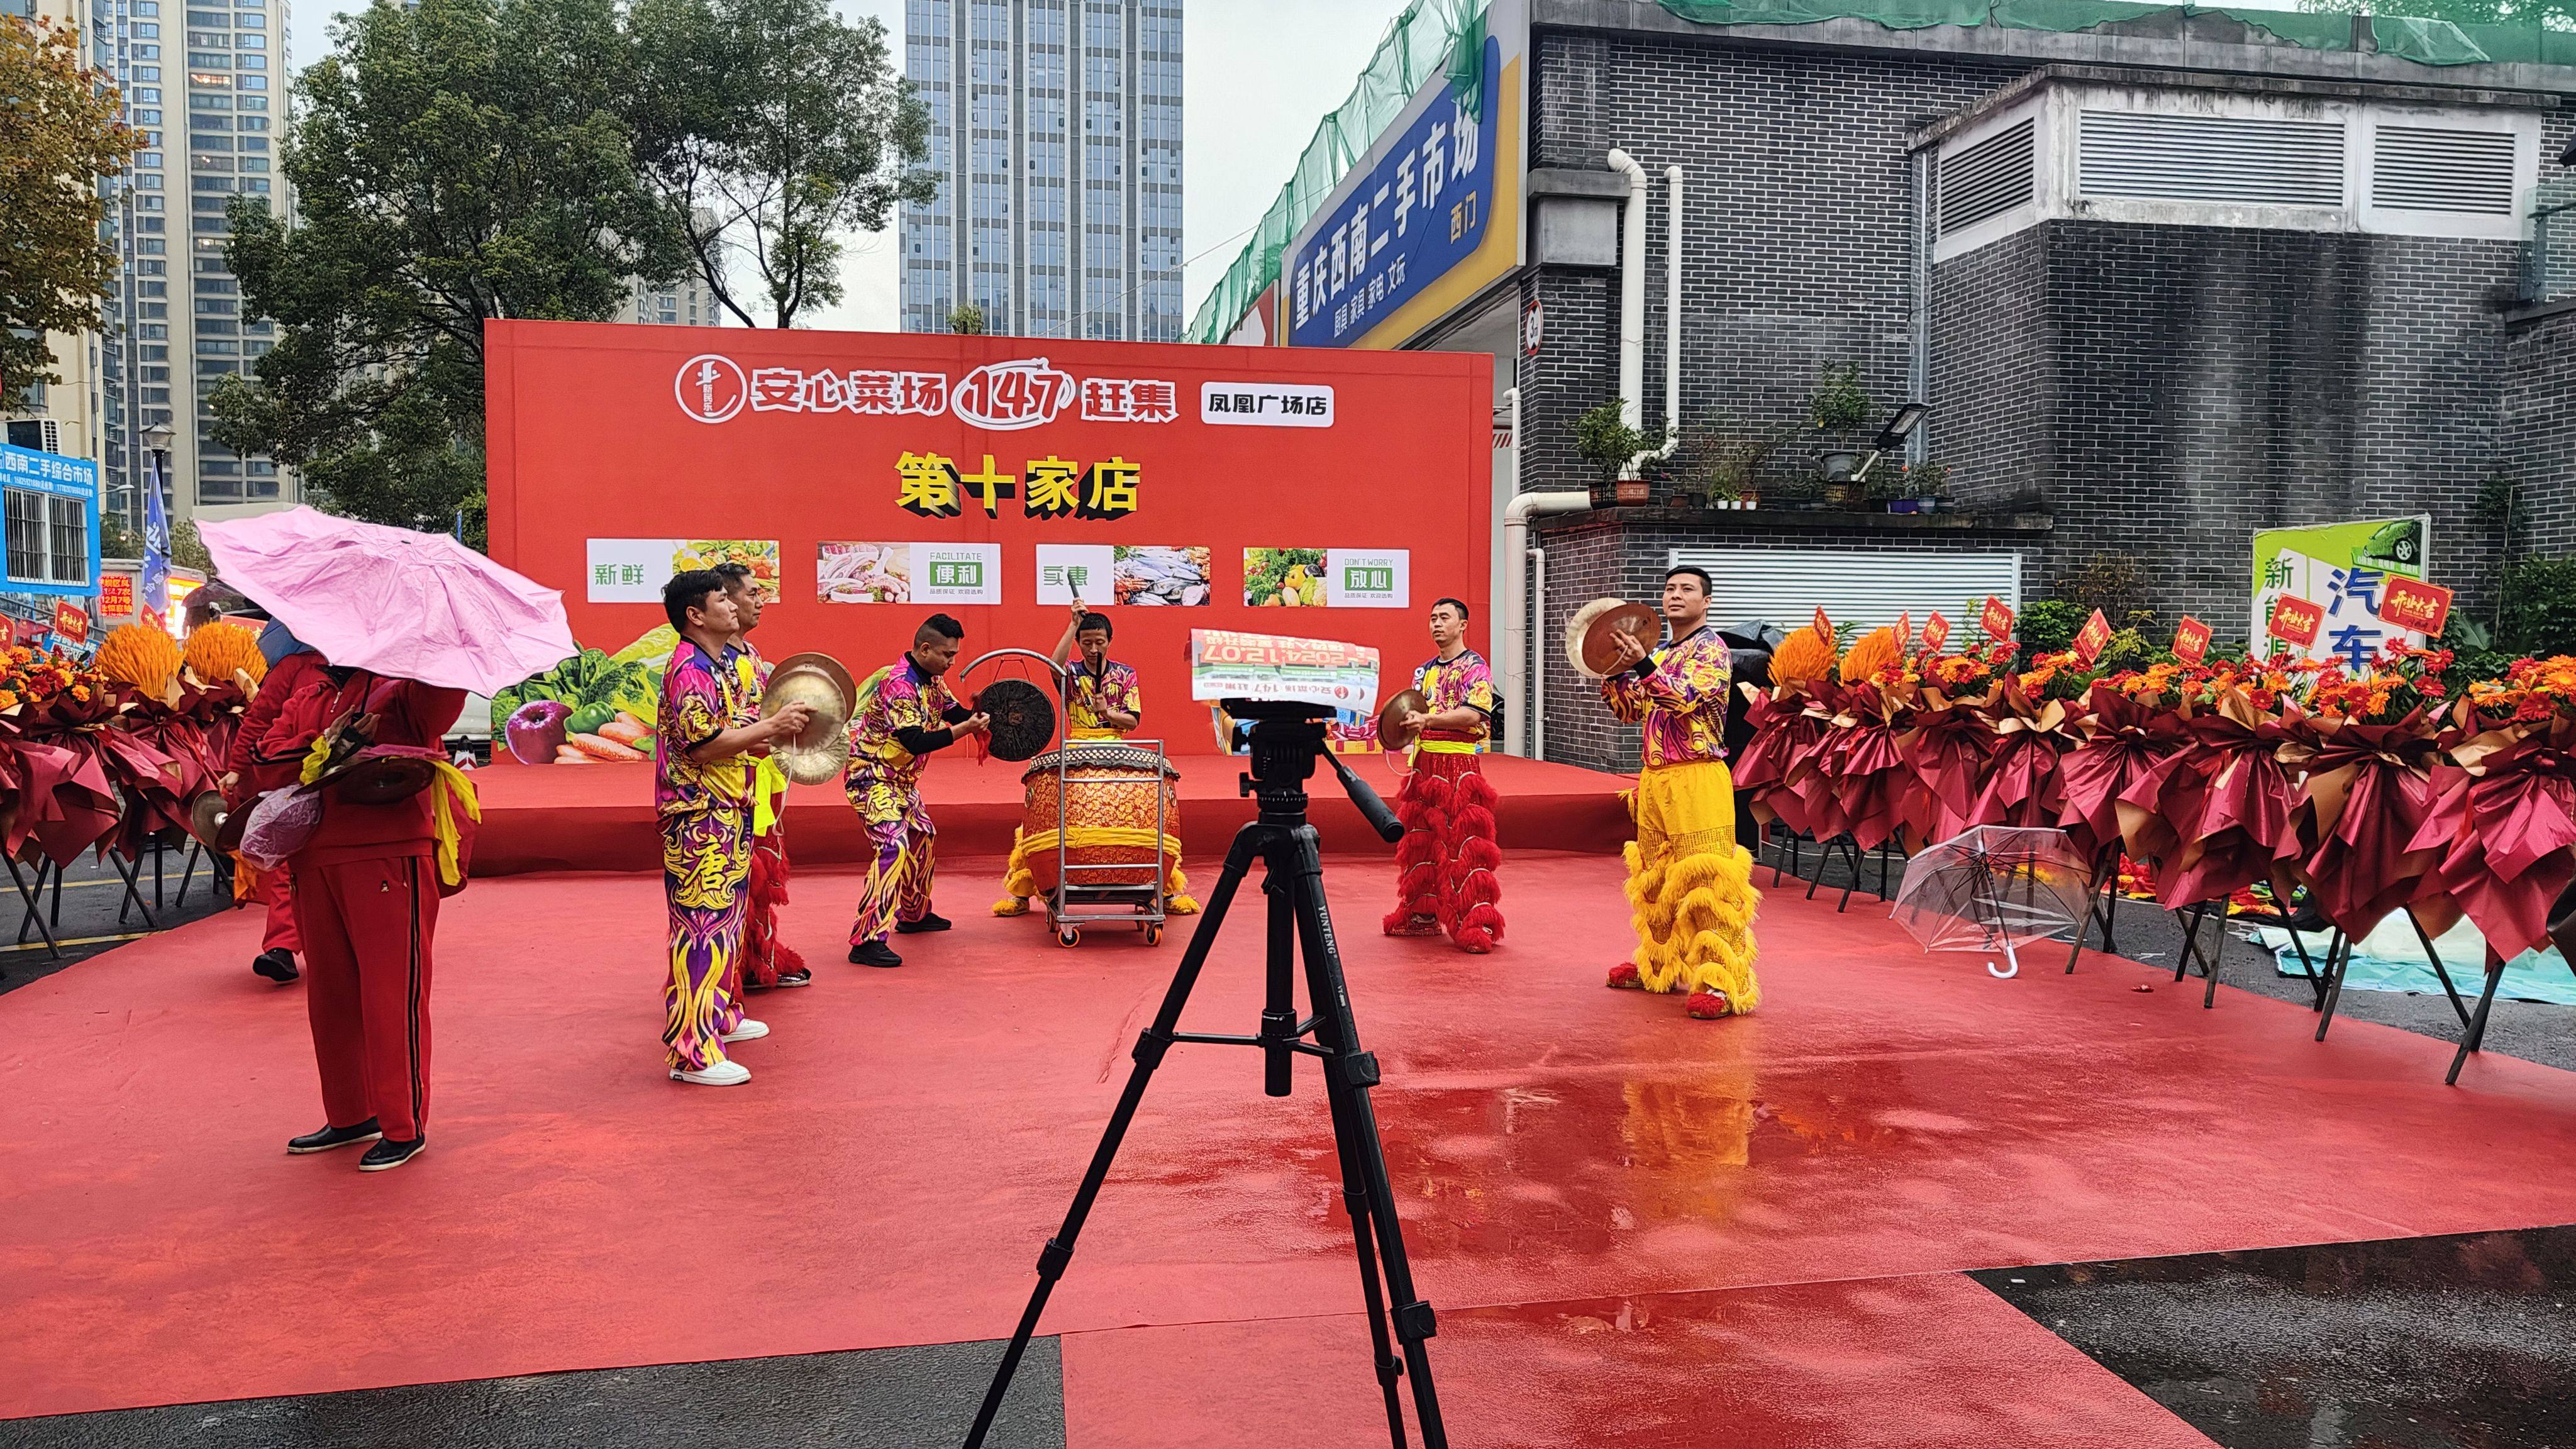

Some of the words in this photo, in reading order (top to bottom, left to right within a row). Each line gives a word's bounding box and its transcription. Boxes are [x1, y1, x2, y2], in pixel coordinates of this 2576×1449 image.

[1296, 102, 1479, 331] 重庆西南二手市场
[1450, 191, 1477, 245] 西门
[1334, 303, 1348, 338] 厨具
[1350, 287, 1365, 325] 家具
[1368, 272, 1384, 310] 家电
[1387, 252, 1406, 295] 文玩
[750, 367, 947, 416] 安心菜场
[960, 364, 1068, 424] 147
[1080, 379, 1179, 423] 赶集
[1208, 393, 1327, 416] 凤凰广场店
[894, 450, 1141, 518] 第十家店
[930, 552, 982, 560] FACILITATE
[595, 564, 644, 586] 新鲜
[936, 565, 977, 584] 便利
[1043, 565, 1088, 586] 实惠
[1350, 570, 1387, 588] 放心
[2390, 589, 2440, 619] 开业大吉
[60, 611, 83, 633] 开业大吉
[2279, 606, 2315, 633] 开业大吉
[2327, 567, 2384, 674] 汽车
[1204, 645, 1345, 664] 2024.12.07
[1255, 683, 1279, 692] 147
[683, 833, 730, 891] 唐
[1318, 905, 1336, 954] YUNTENG
